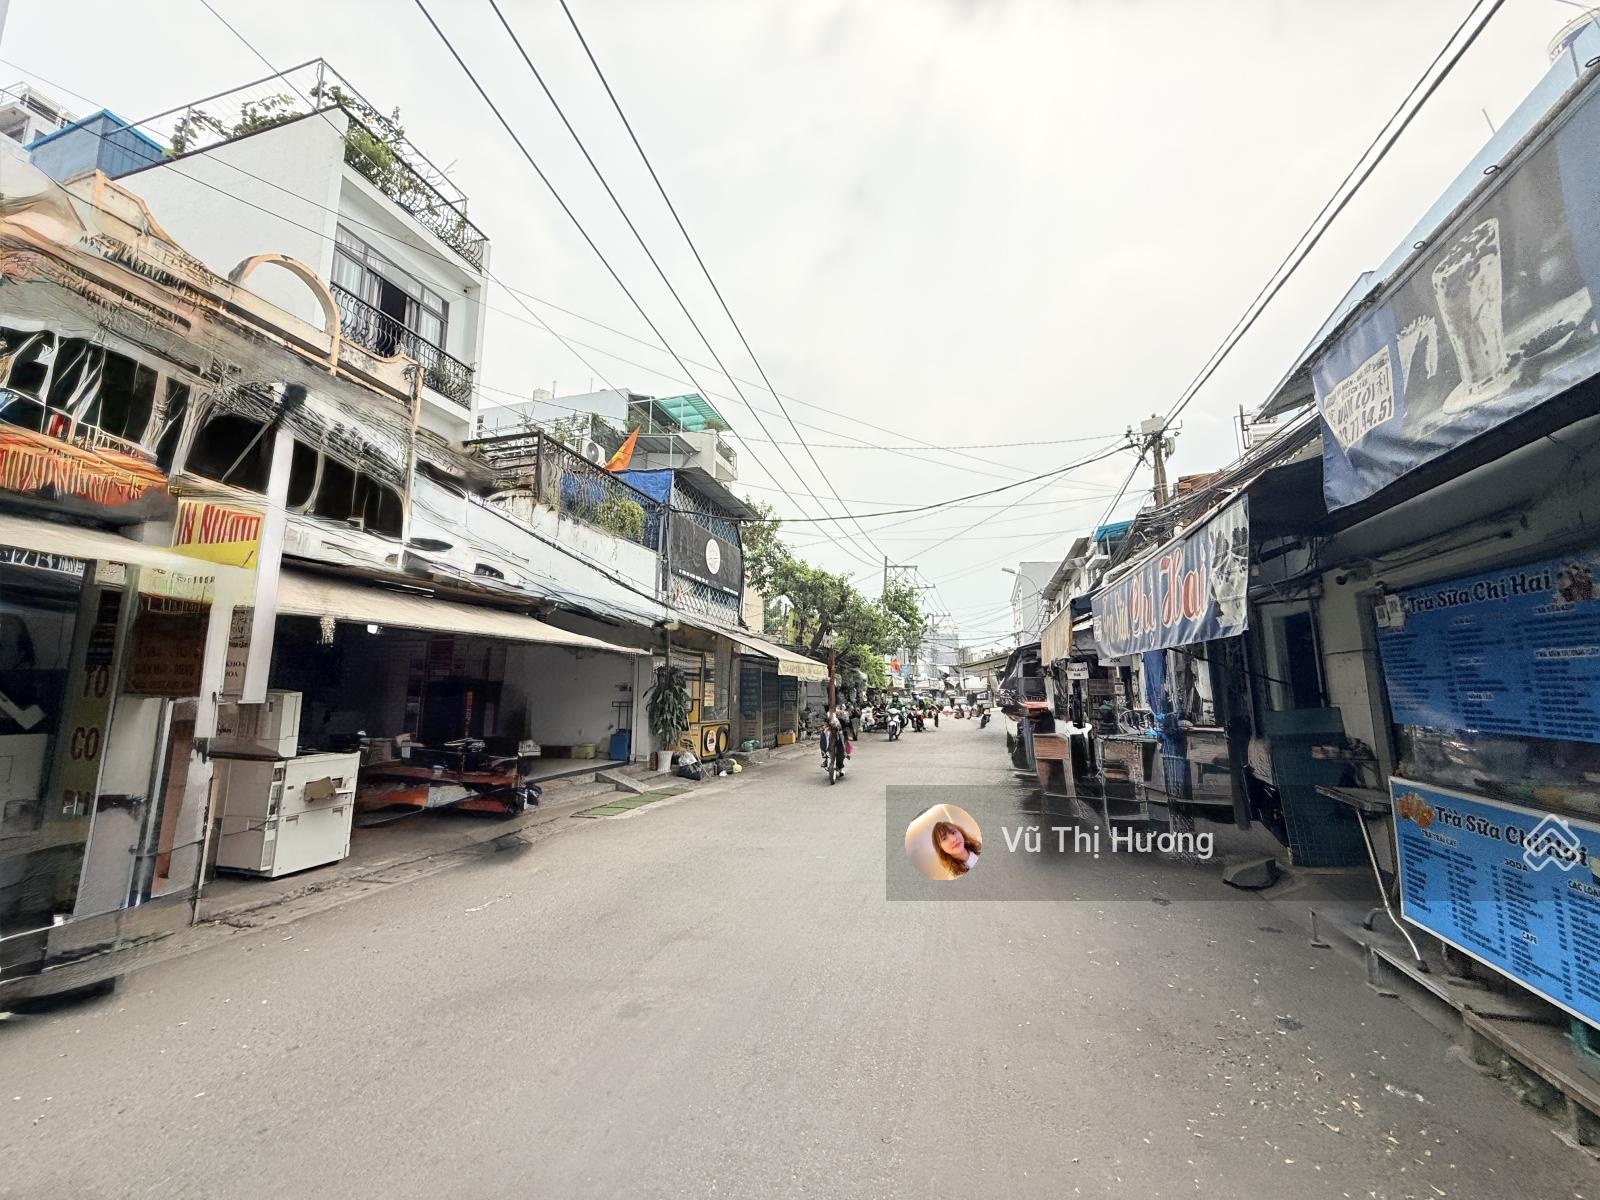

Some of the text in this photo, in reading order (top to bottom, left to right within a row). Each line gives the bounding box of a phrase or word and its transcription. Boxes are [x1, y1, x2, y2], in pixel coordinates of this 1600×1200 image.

[1159, 543, 1209, 629] Hai
[1437, 589, 1471, 608] Sữa
[1473, 579, 1508, 603] Chị
[1510, 569, 1553, 595] Hai
[1435, 805, 1462, 828] Trà
[1466, 815, 1501, 840] Sữa
